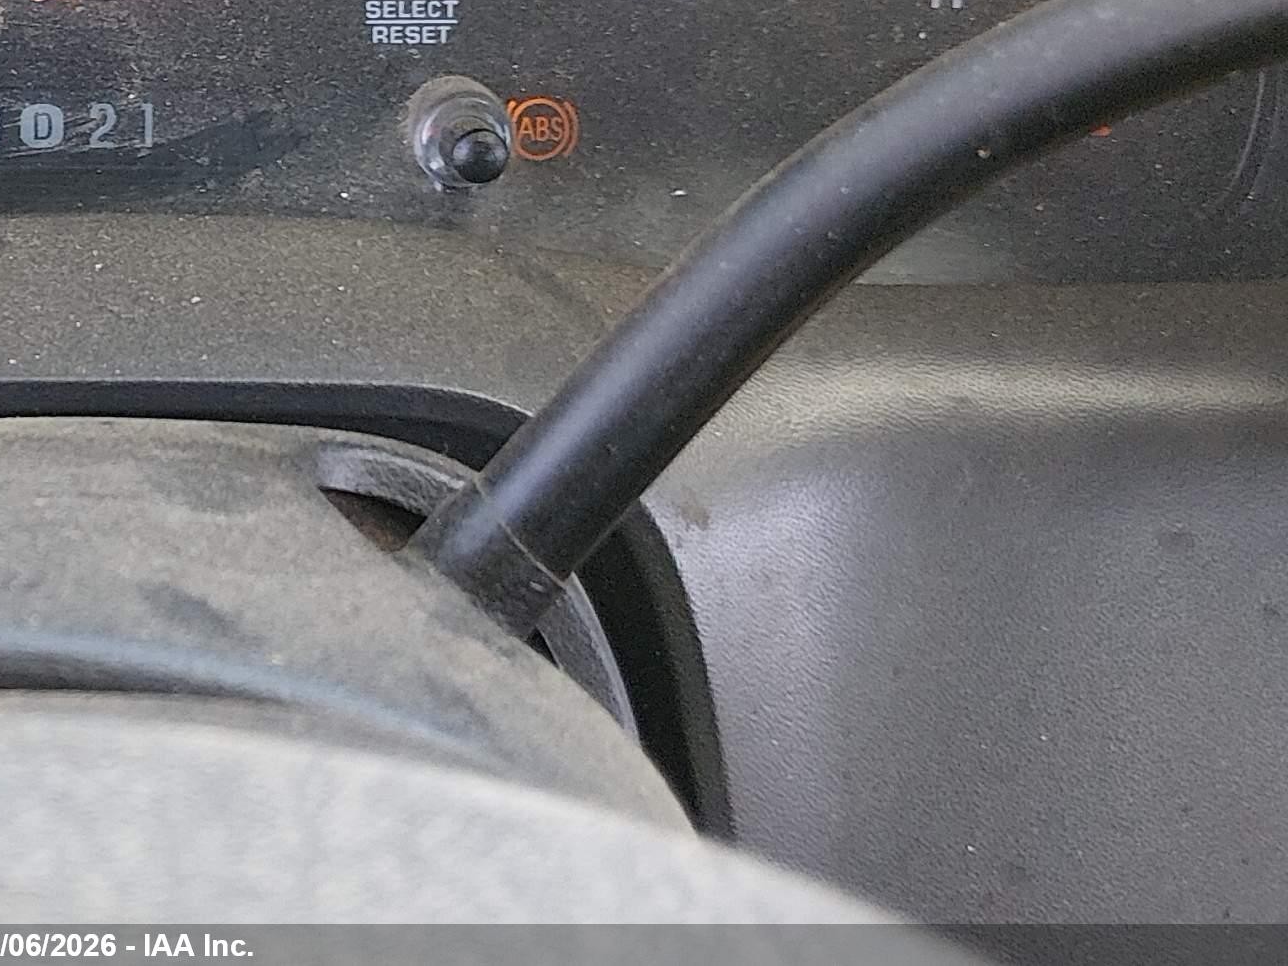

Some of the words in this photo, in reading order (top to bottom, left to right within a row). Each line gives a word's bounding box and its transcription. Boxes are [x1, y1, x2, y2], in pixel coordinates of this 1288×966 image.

[365, 0, 459, 17] SELECT
[371, 25, 452, 44] RESET
[89, 103, 117, 148] 2
[519, 117, 562, 141] ABS
